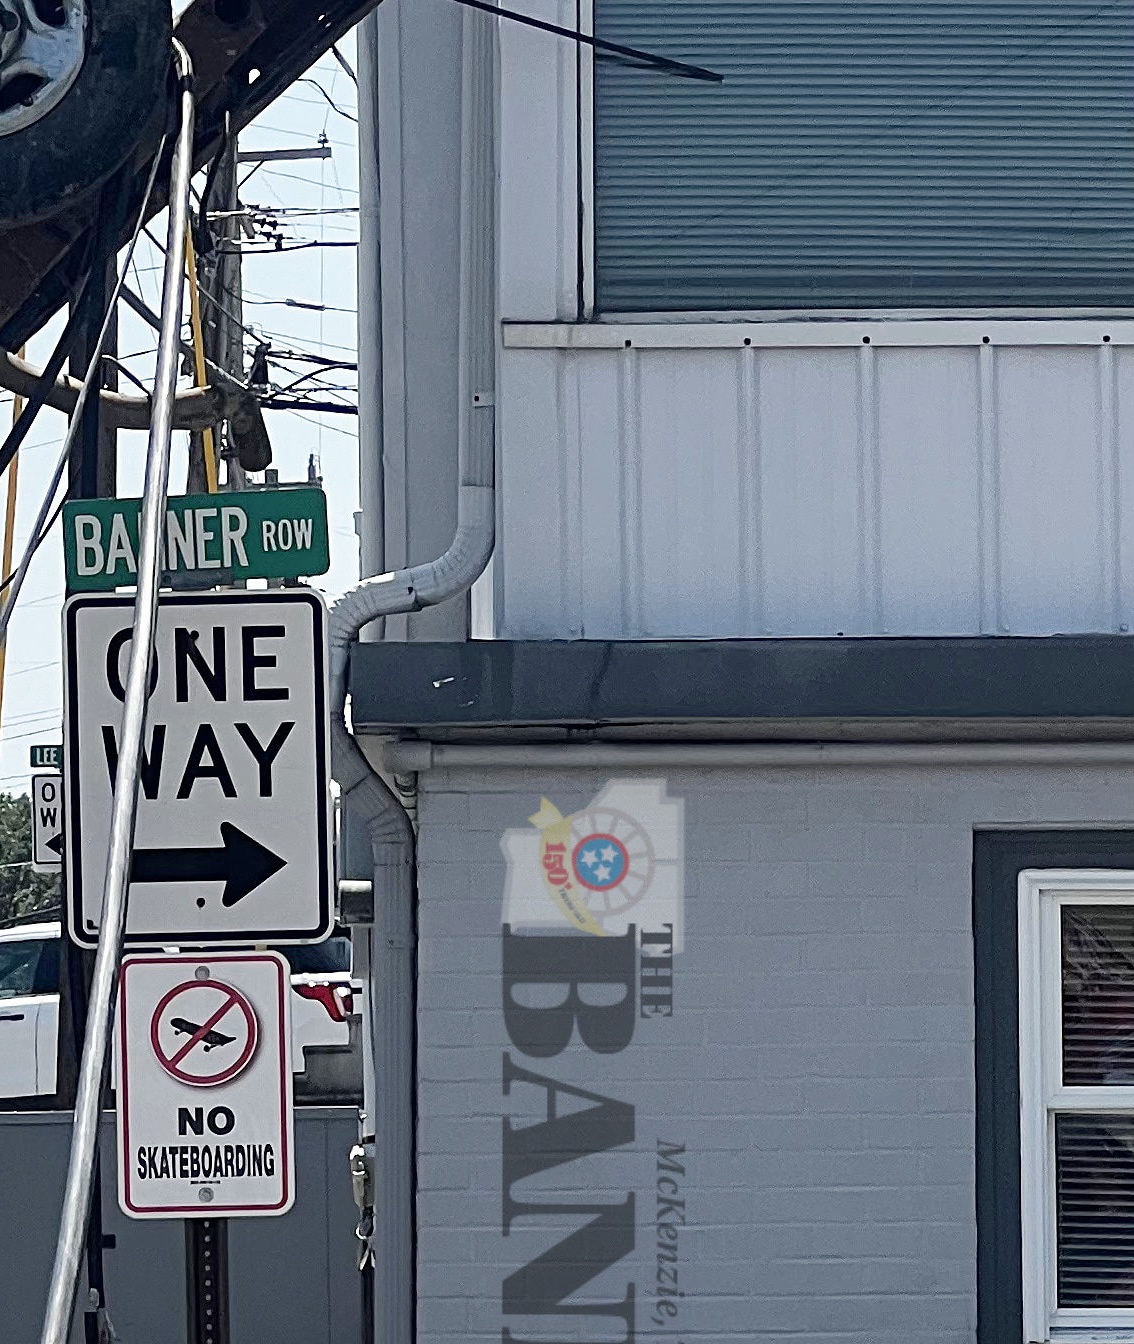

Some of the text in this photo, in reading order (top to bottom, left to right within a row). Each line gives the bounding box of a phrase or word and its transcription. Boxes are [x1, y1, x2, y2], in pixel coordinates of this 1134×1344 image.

[262, 519, 313, 552] ROW
[106, 625, 290, 703] ONE
[36, 747, 58, 765] LEE
[101, 721, 296, 800] WAY
[178, 1106, 235, 1136] NO
[137, 1143, 275, 1180] SKATEBOARDING
